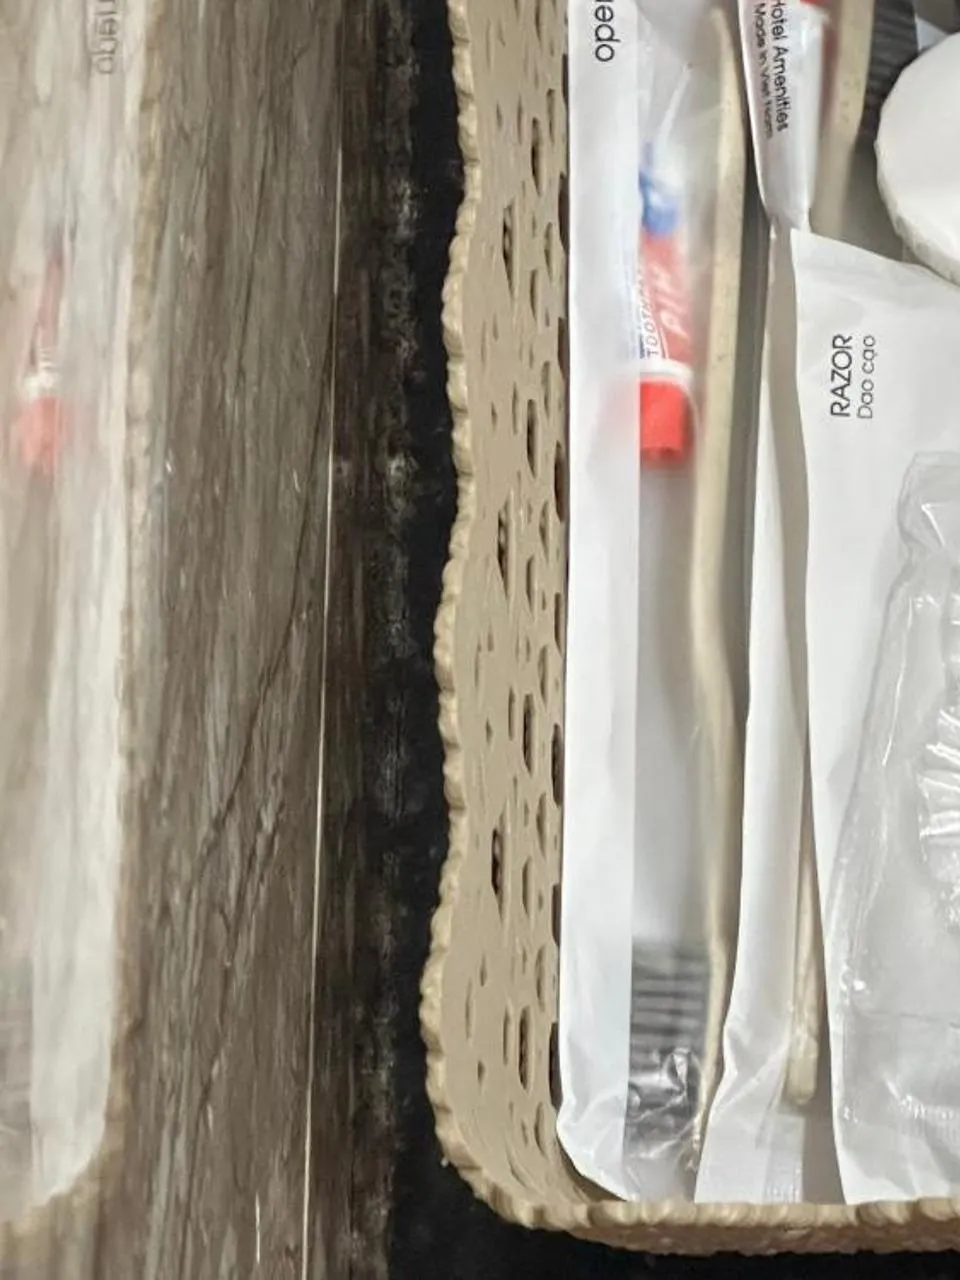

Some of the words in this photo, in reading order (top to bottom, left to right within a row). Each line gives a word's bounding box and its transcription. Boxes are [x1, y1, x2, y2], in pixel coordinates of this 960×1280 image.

[773, 45, 791, 133] Amenities
[830, 333, 853, 417] RAZOR
[857, 379, 875, 419] Dao
